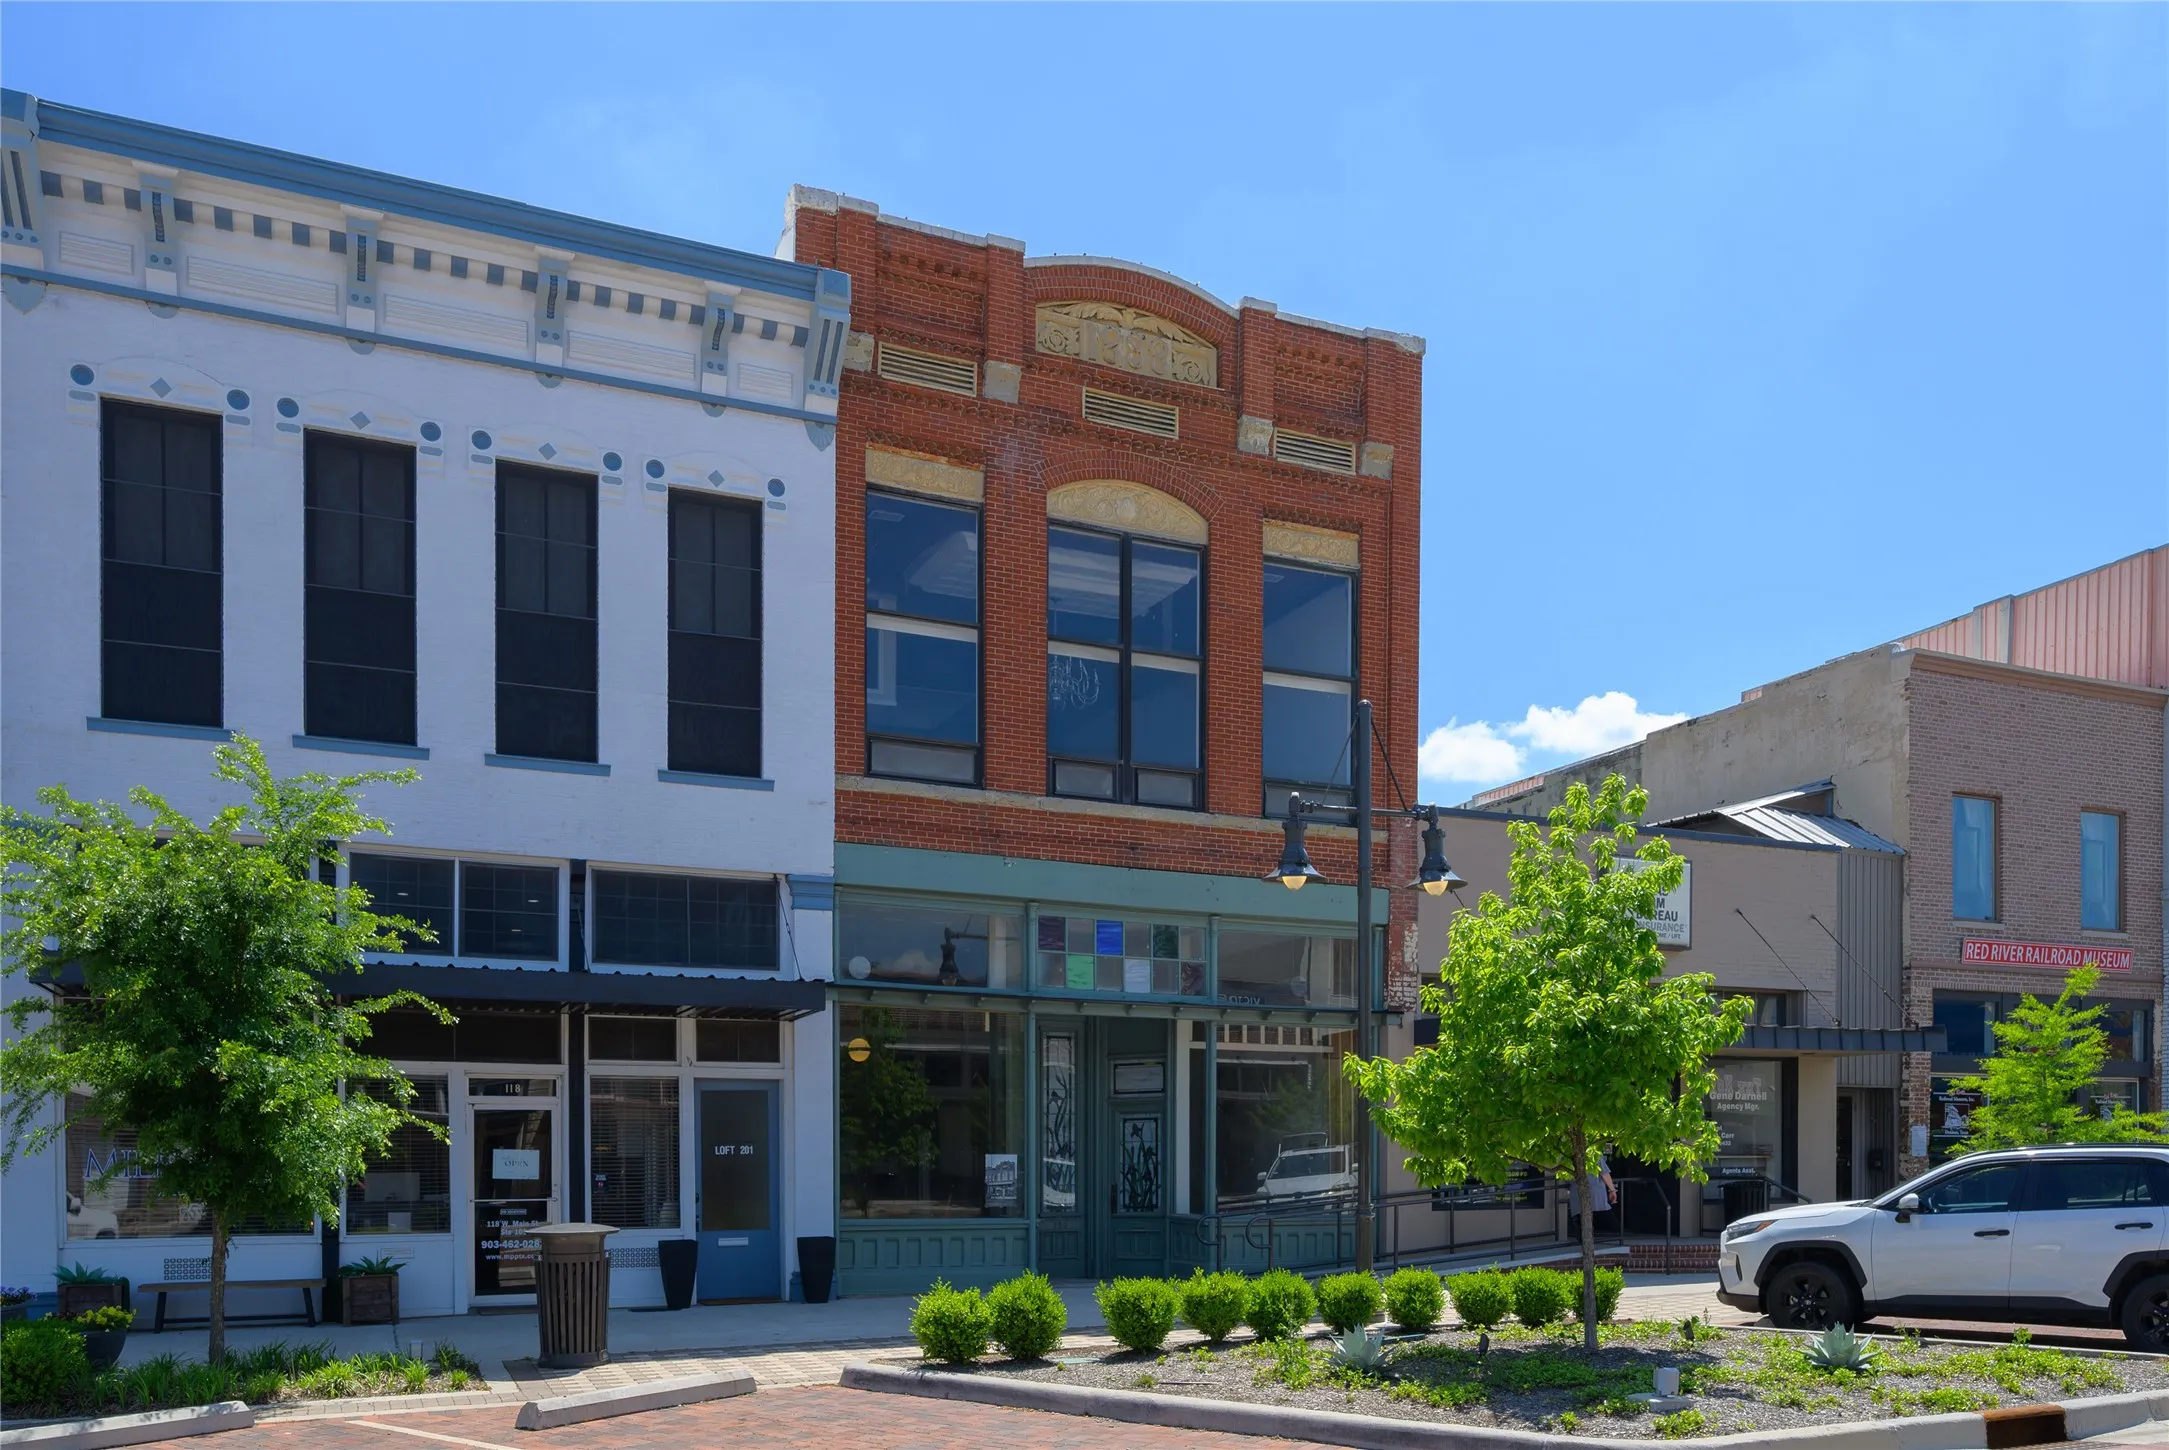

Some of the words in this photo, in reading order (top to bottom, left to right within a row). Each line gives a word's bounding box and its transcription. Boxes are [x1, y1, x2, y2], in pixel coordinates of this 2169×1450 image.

[1966, 942, 1989, 960] RED
[1991, 944, 2024, 963] RIVER
[2025, 946, 2082, 966] RAILROAD
[2082, 950, 2130, 969] MUSEUM
[505, 1083, 521, 1093] 118
[1709, 1091, 1733, 1101] Gene
[1734, 1091, 1767, 1101] Darnell
[1717, 1102, 1744, 1111] Agency
[1744, 1102, 1760, 1111] Mgr.
[714, 1145, 735, 1155] LOFT
[739, 1145, 754, 1155] 201
[486, 1220, 500, 1228] 118
[512, 1220, 529, 1228] Main
[500, 1228, 511, 1236] Ste
[481, 1239, 542, 1249] 903-462-028
